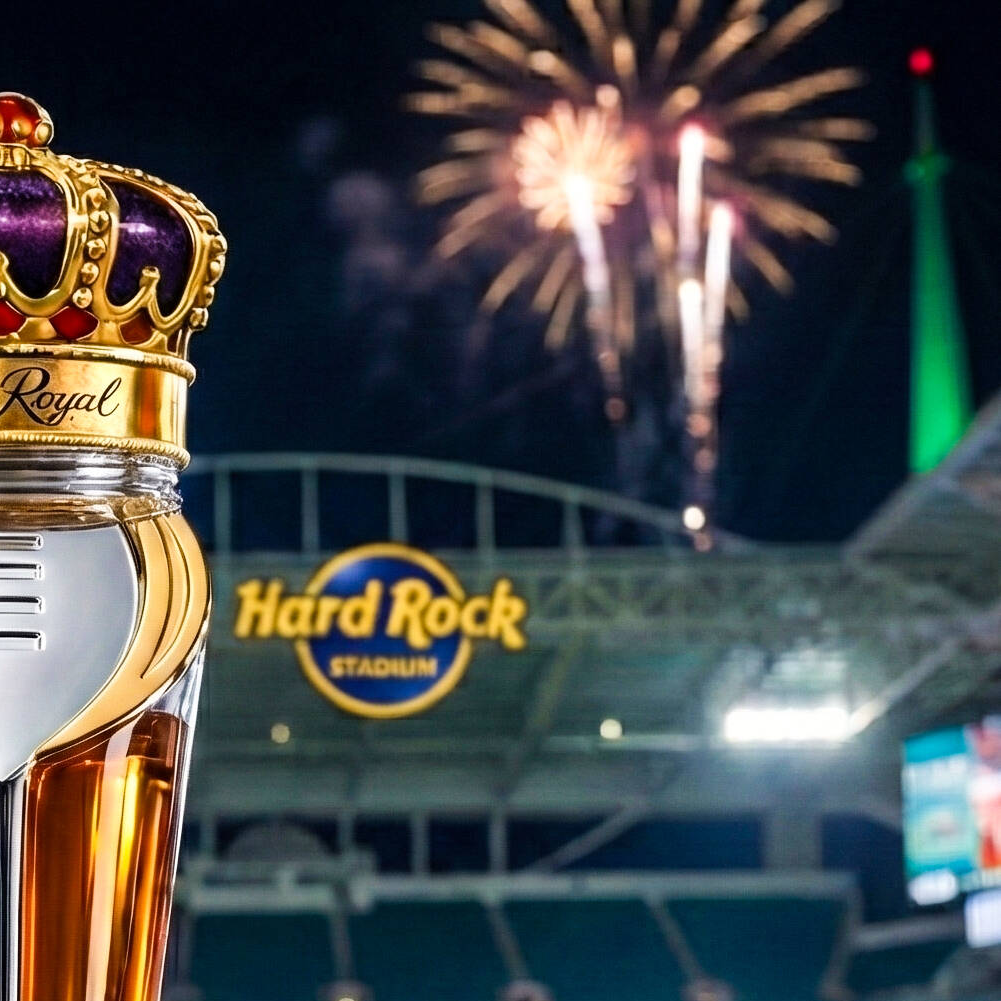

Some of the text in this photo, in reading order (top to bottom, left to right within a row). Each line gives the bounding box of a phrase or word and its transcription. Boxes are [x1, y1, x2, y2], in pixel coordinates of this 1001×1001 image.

[234, 577, 528, 650] Hard Rock
[330, 656, 438, 678] STADIUM
